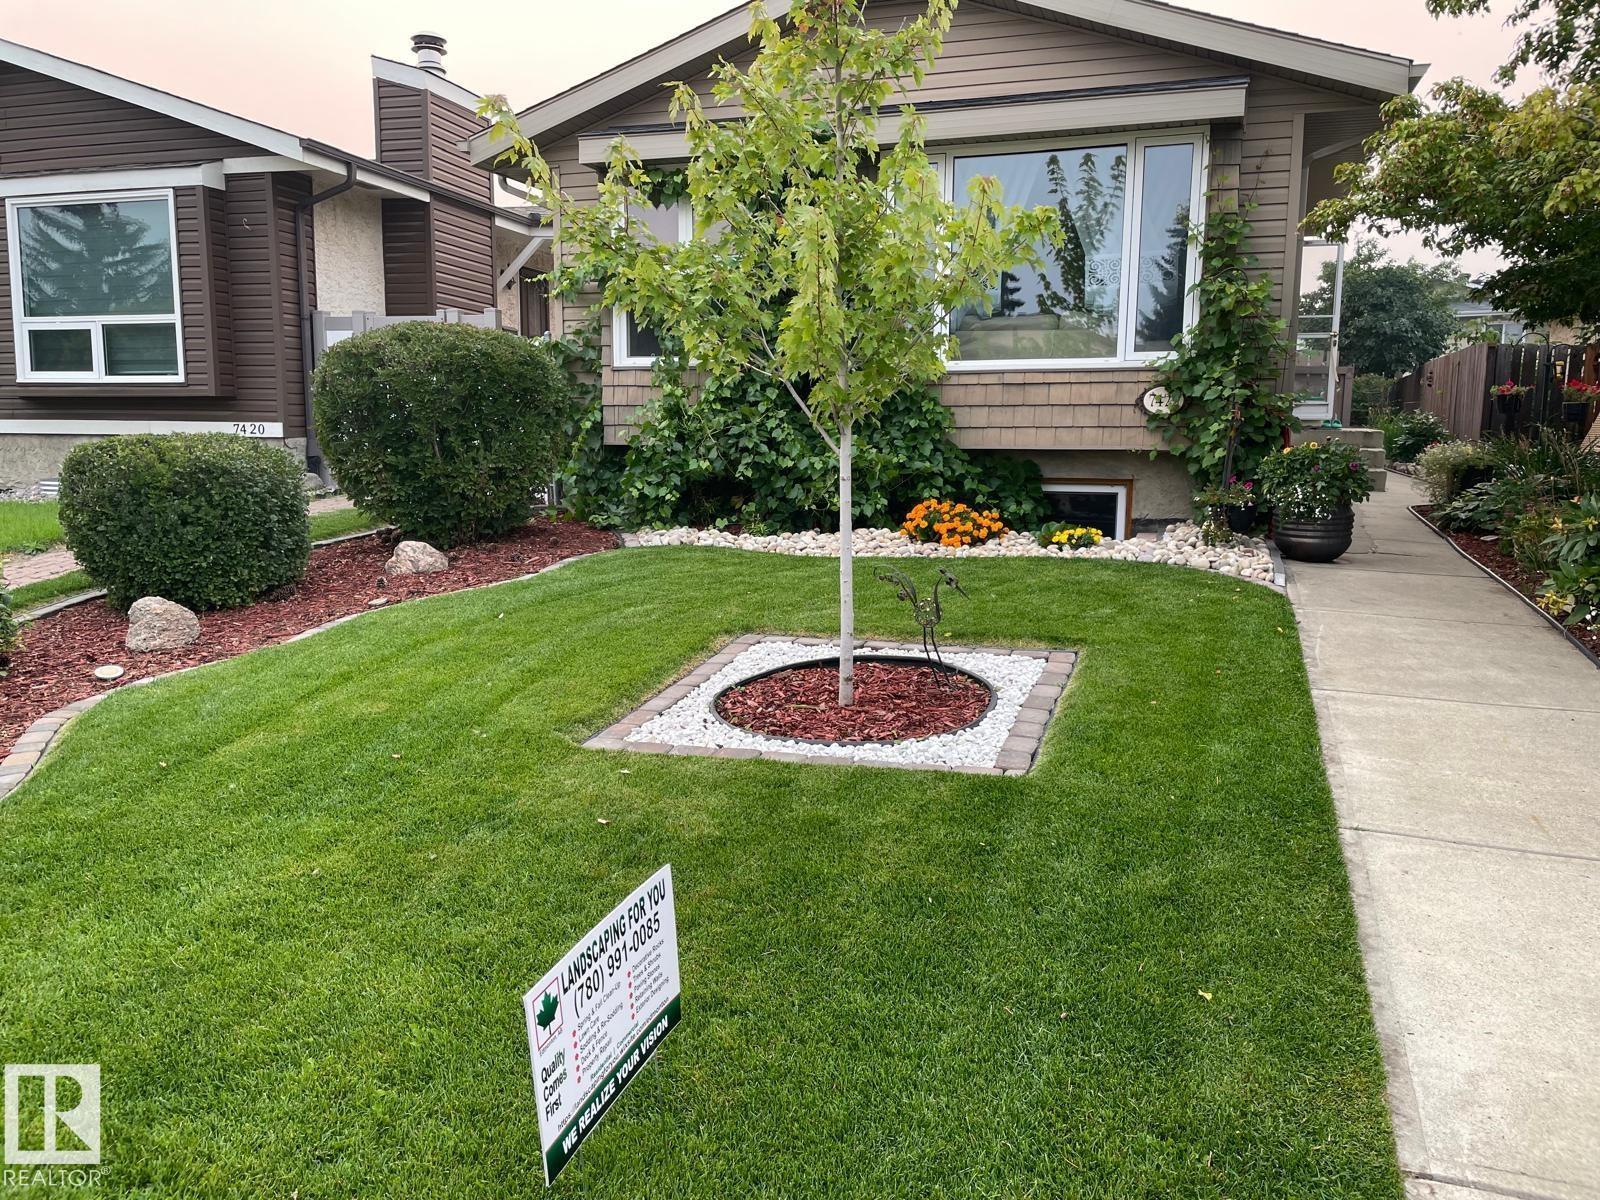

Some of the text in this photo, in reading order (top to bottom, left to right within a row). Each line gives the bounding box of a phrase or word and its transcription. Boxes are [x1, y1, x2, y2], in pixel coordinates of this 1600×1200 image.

[232, 423, 265, 435] 7420
[561, 878, 665, 995] LANDSCAPING FOR YOU
[574, 910, 660, 1018] (780) 991-0085
[577, 1013, 591, 1031] Spring
[590, 1016, 599, 1029] Care
[541, 1049, 565, 1084] Quality
[543, 1068, 567, 1102] Comes
[562, 1015, 668, 1154] WE REALIZE YOUR VISION
[545, 1093, 562, 1122] First
